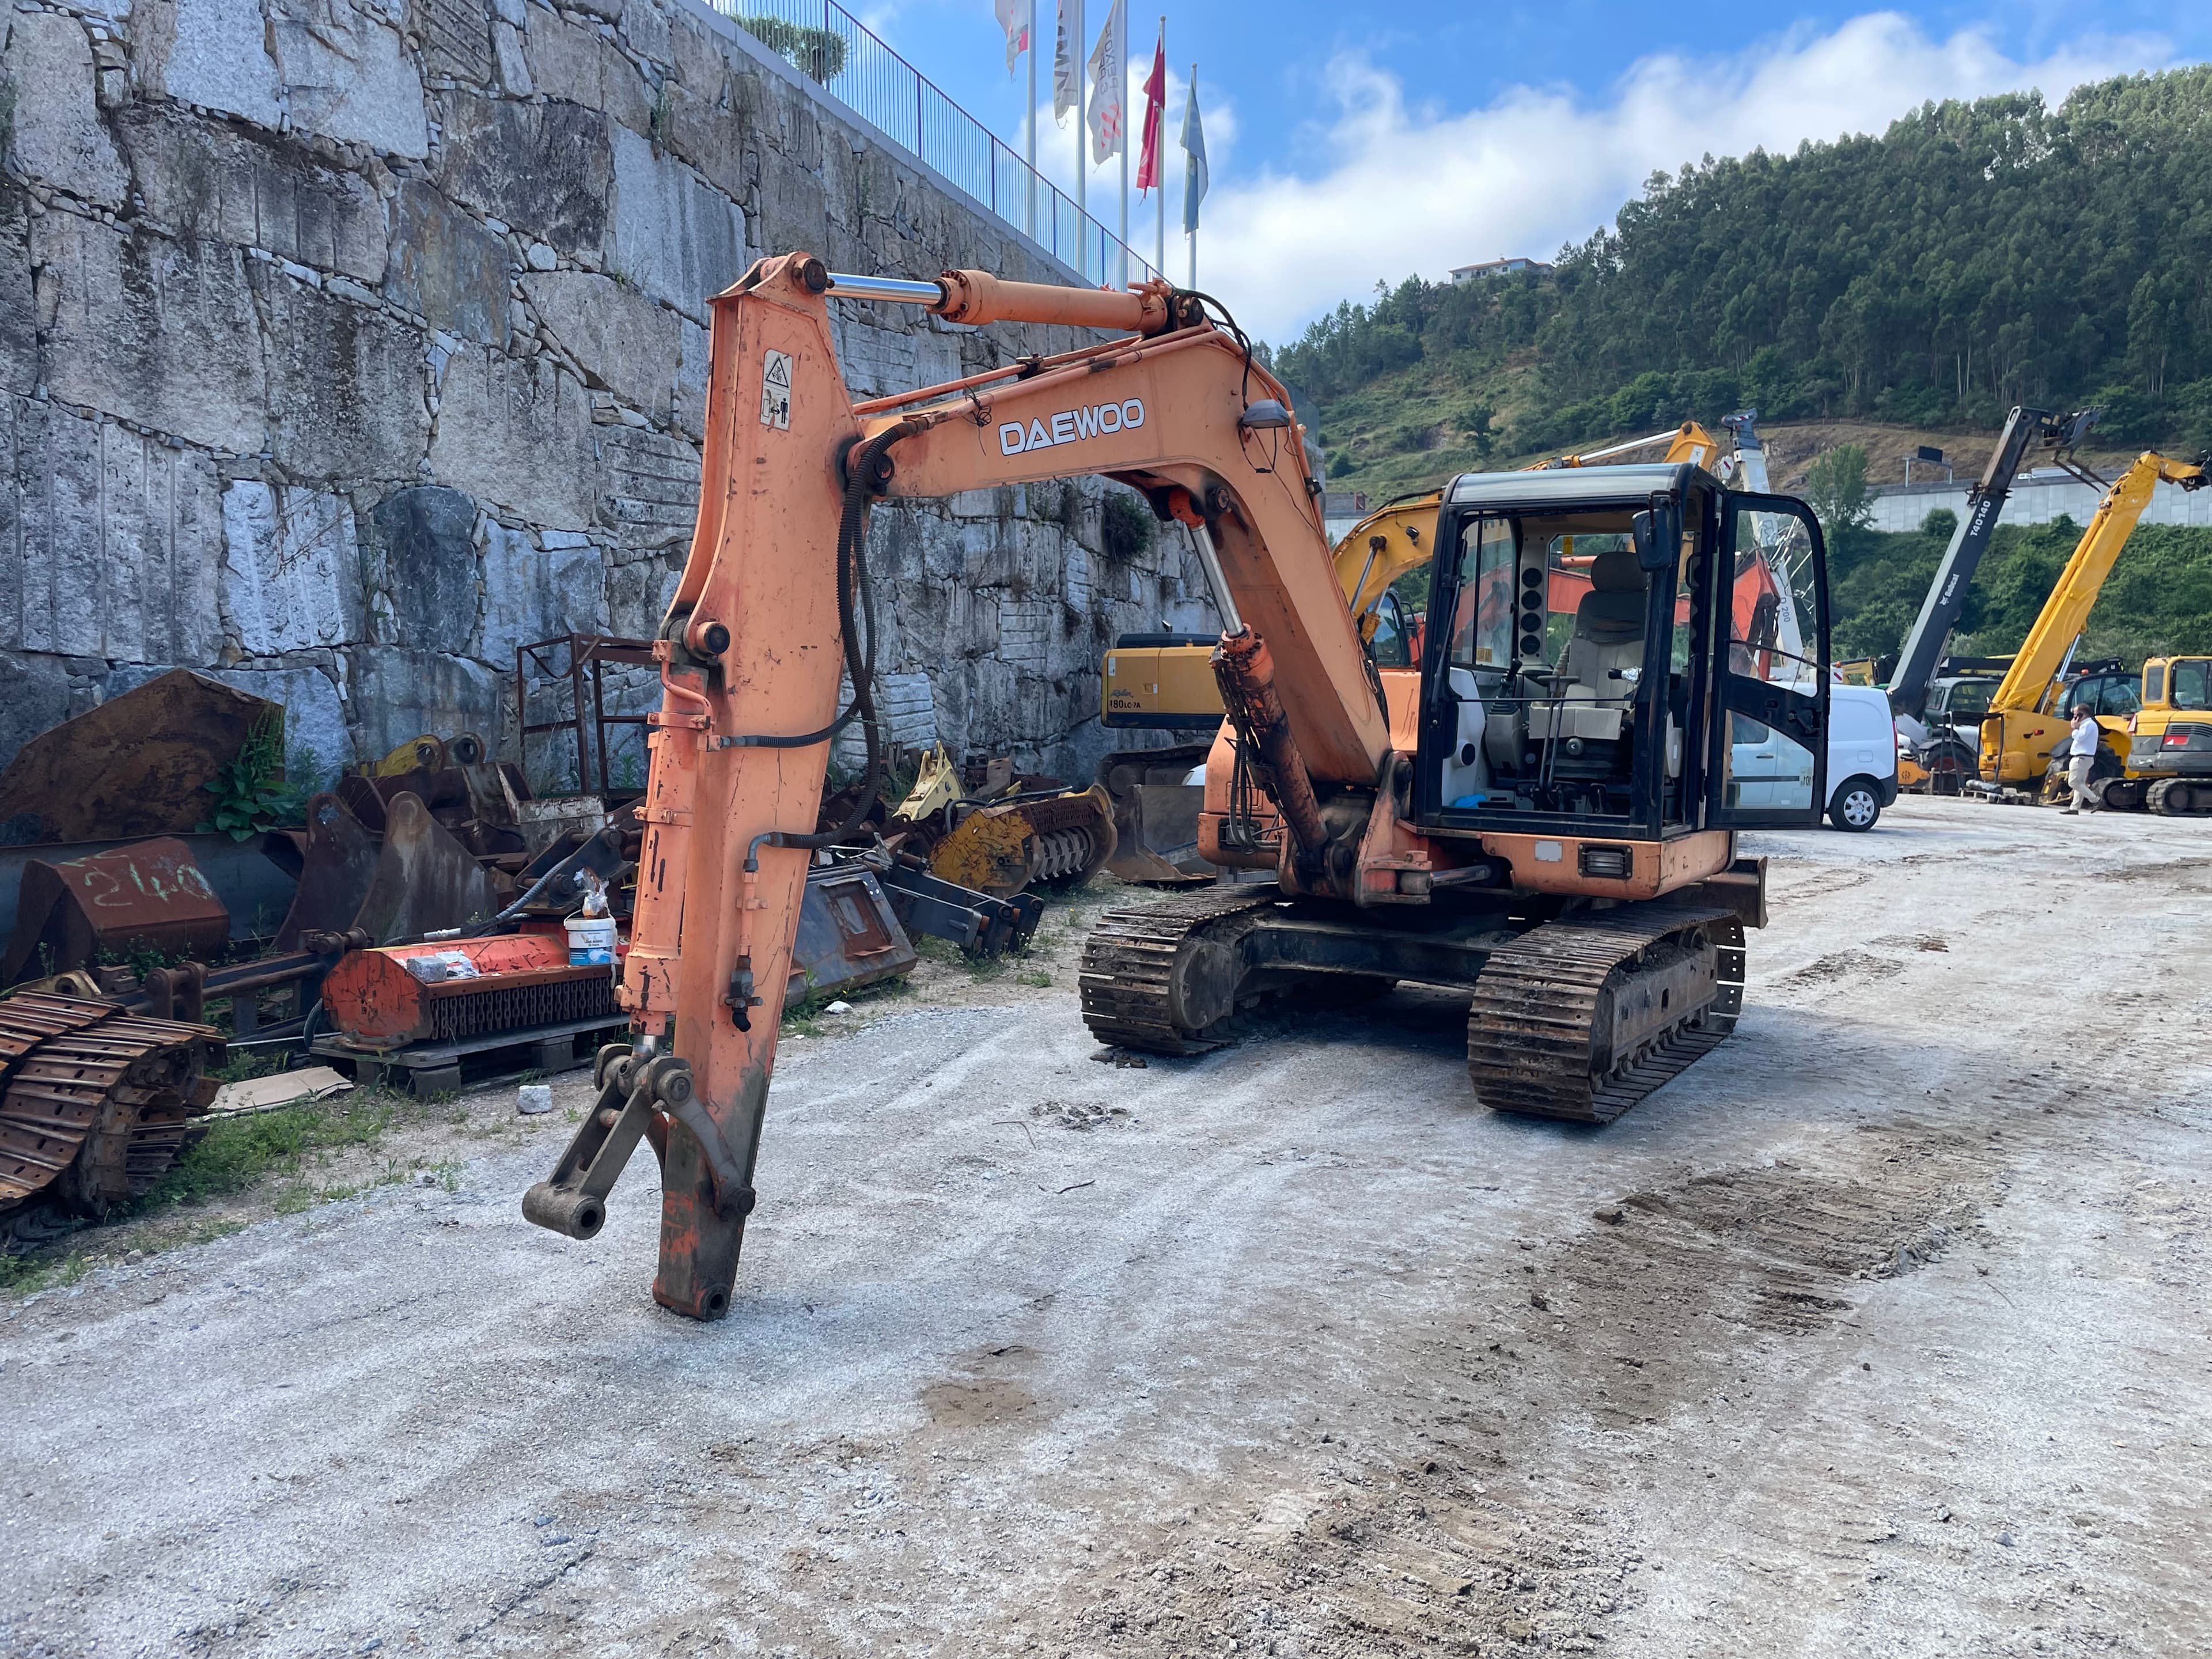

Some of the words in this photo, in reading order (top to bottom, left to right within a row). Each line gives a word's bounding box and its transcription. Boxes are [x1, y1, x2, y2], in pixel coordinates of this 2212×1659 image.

[999, 398, 1145, 456] DAEWOO
[1969, 500, 1991, 536] T40140
[1781, 606, 1791, 623] 200
[84, 863, 213, 907] 240
